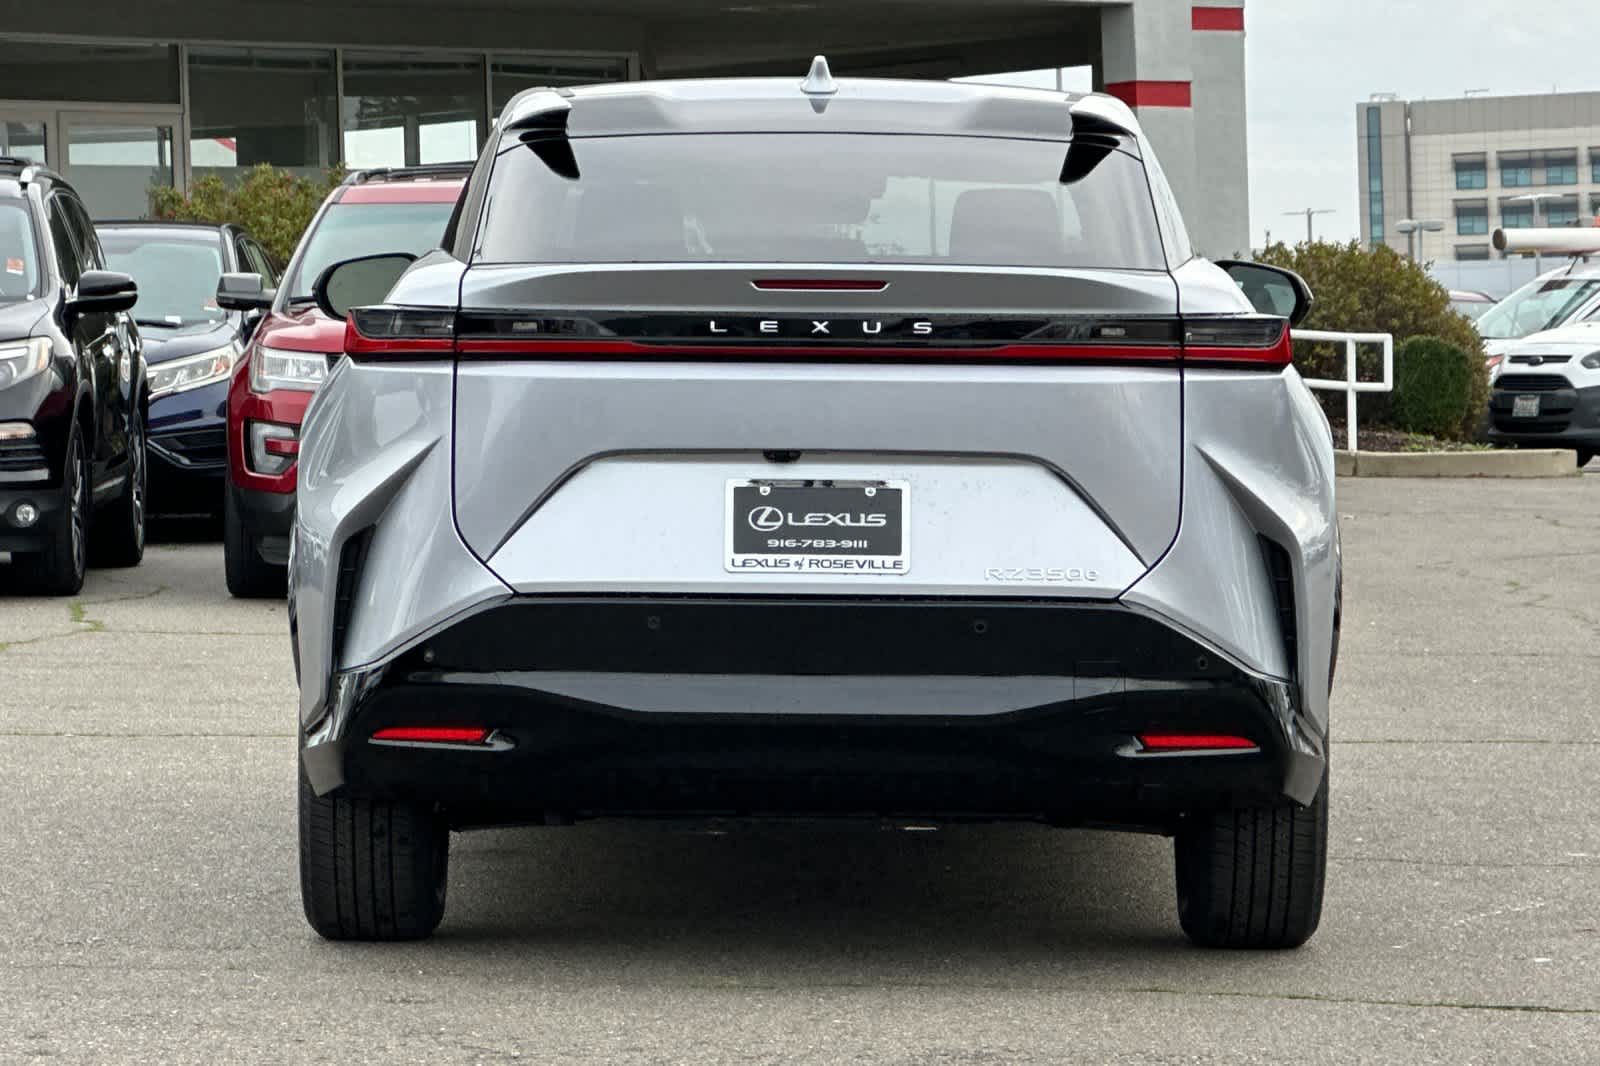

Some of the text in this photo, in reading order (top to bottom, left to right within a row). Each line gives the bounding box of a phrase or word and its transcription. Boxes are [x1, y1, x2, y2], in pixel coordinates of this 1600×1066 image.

[709, 320, 932, 334] LEXUS
[787, 512, 887, 527] LEXUS
[767, 539, 868, 549] 916-783-9111
[731, 557, 904, 571] LEXUS of ROSEVILLE
